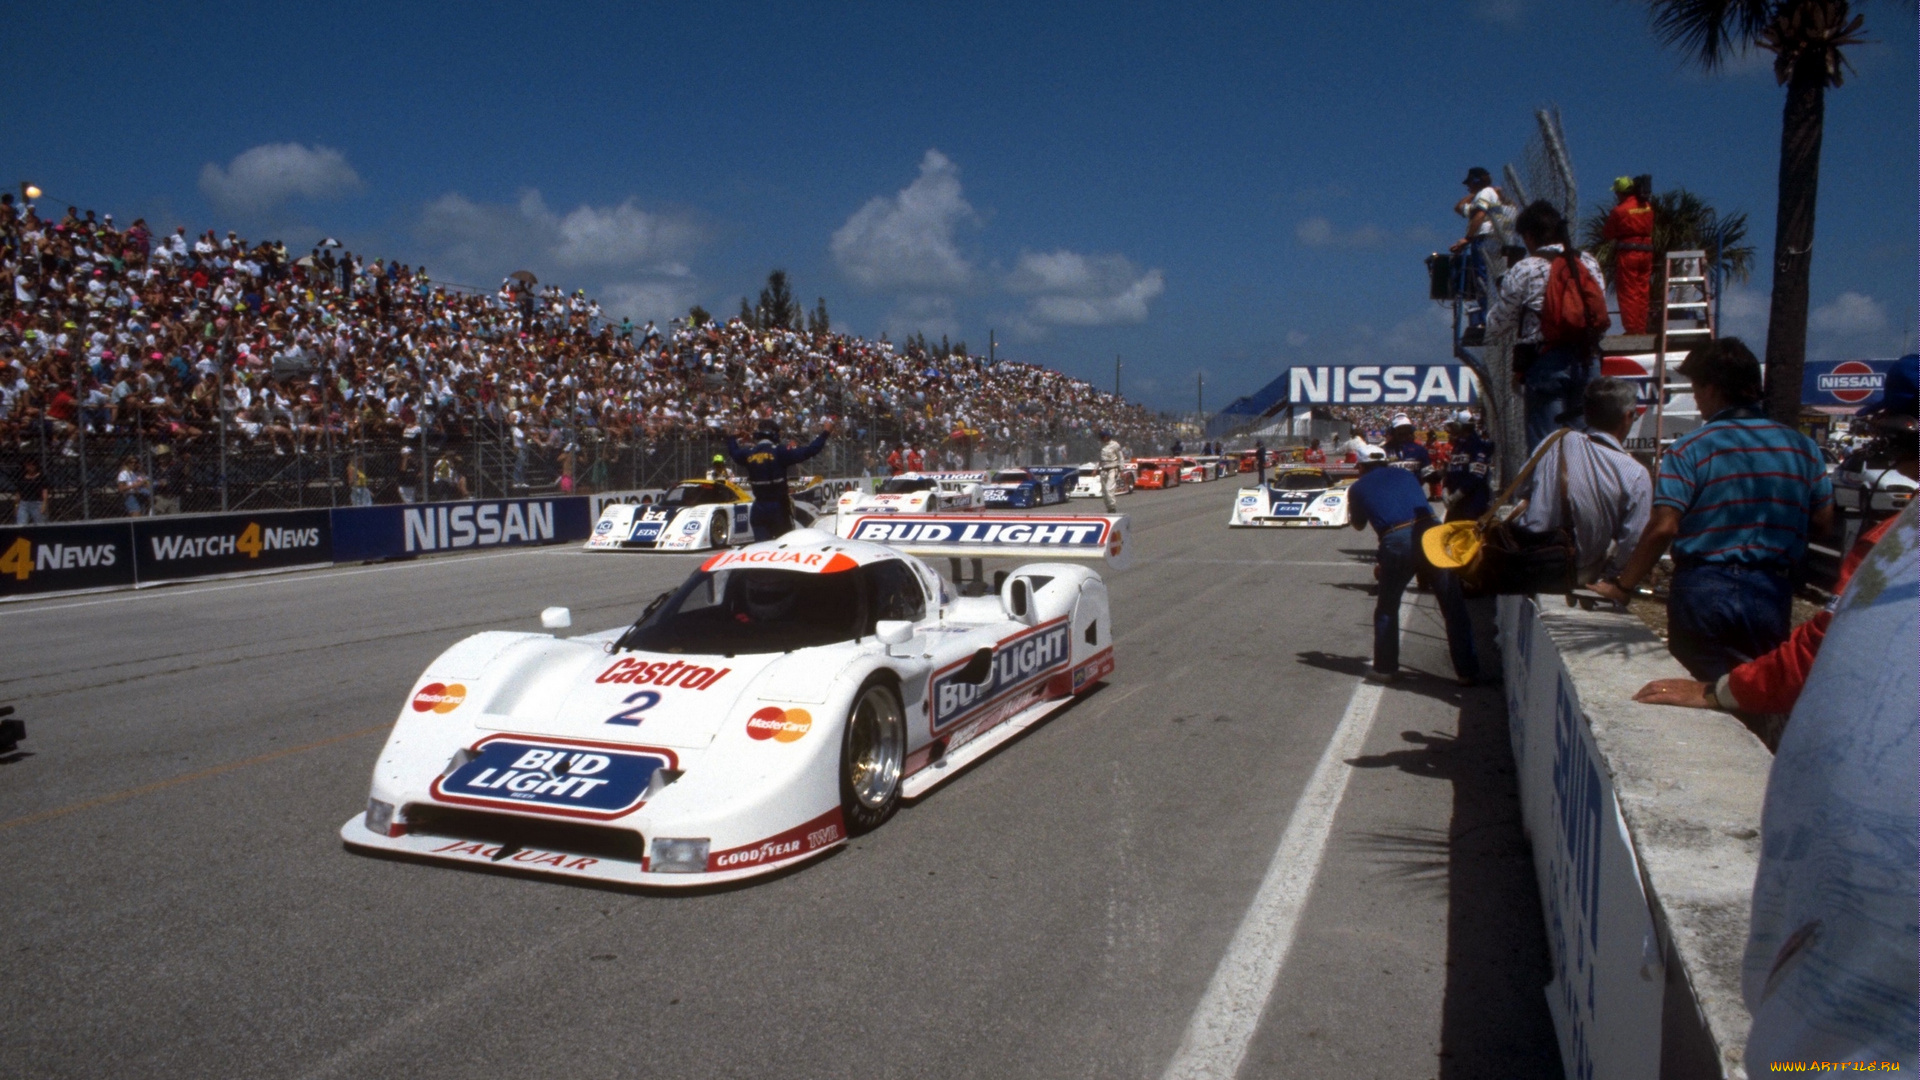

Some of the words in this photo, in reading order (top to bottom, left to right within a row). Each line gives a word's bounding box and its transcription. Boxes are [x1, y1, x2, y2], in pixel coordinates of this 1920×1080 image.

[1821, 376, 1882, 387] NISSAN
[404, 502, 554, 552] NISSAN
[642, 507, 668, 521] 64
[151, 534, 236, 561] WATCH
[236, 522, 262, 559] 4
[263, 526, 319, 550] NEWS
[636, 528, 659, 536] EDS
[858, 523, 951, 541] BUD
[958, 524, 1098, 545] LIGHT
[0, 537, 35, 580] 4
[36, 543, 116, 571] NEWS
[718, 550, 822, 567] JAGUAR
[1000, 628, 1065, 686] LIGHT
[595, 657, 732, 690] Castrol
[414, 693, 465, 704] MasterCard
[604, 689, 662, 727] 2
[748, 717, 812, 733] MasterCard
[510, 749, 610, 776] BUD
[467, 767, 610, 798] LIGHT
[510, 791, 536, 799] BEER
[807, 824, 839, 849] TWR
[716, 840, 801, 867] GOODYEAR
